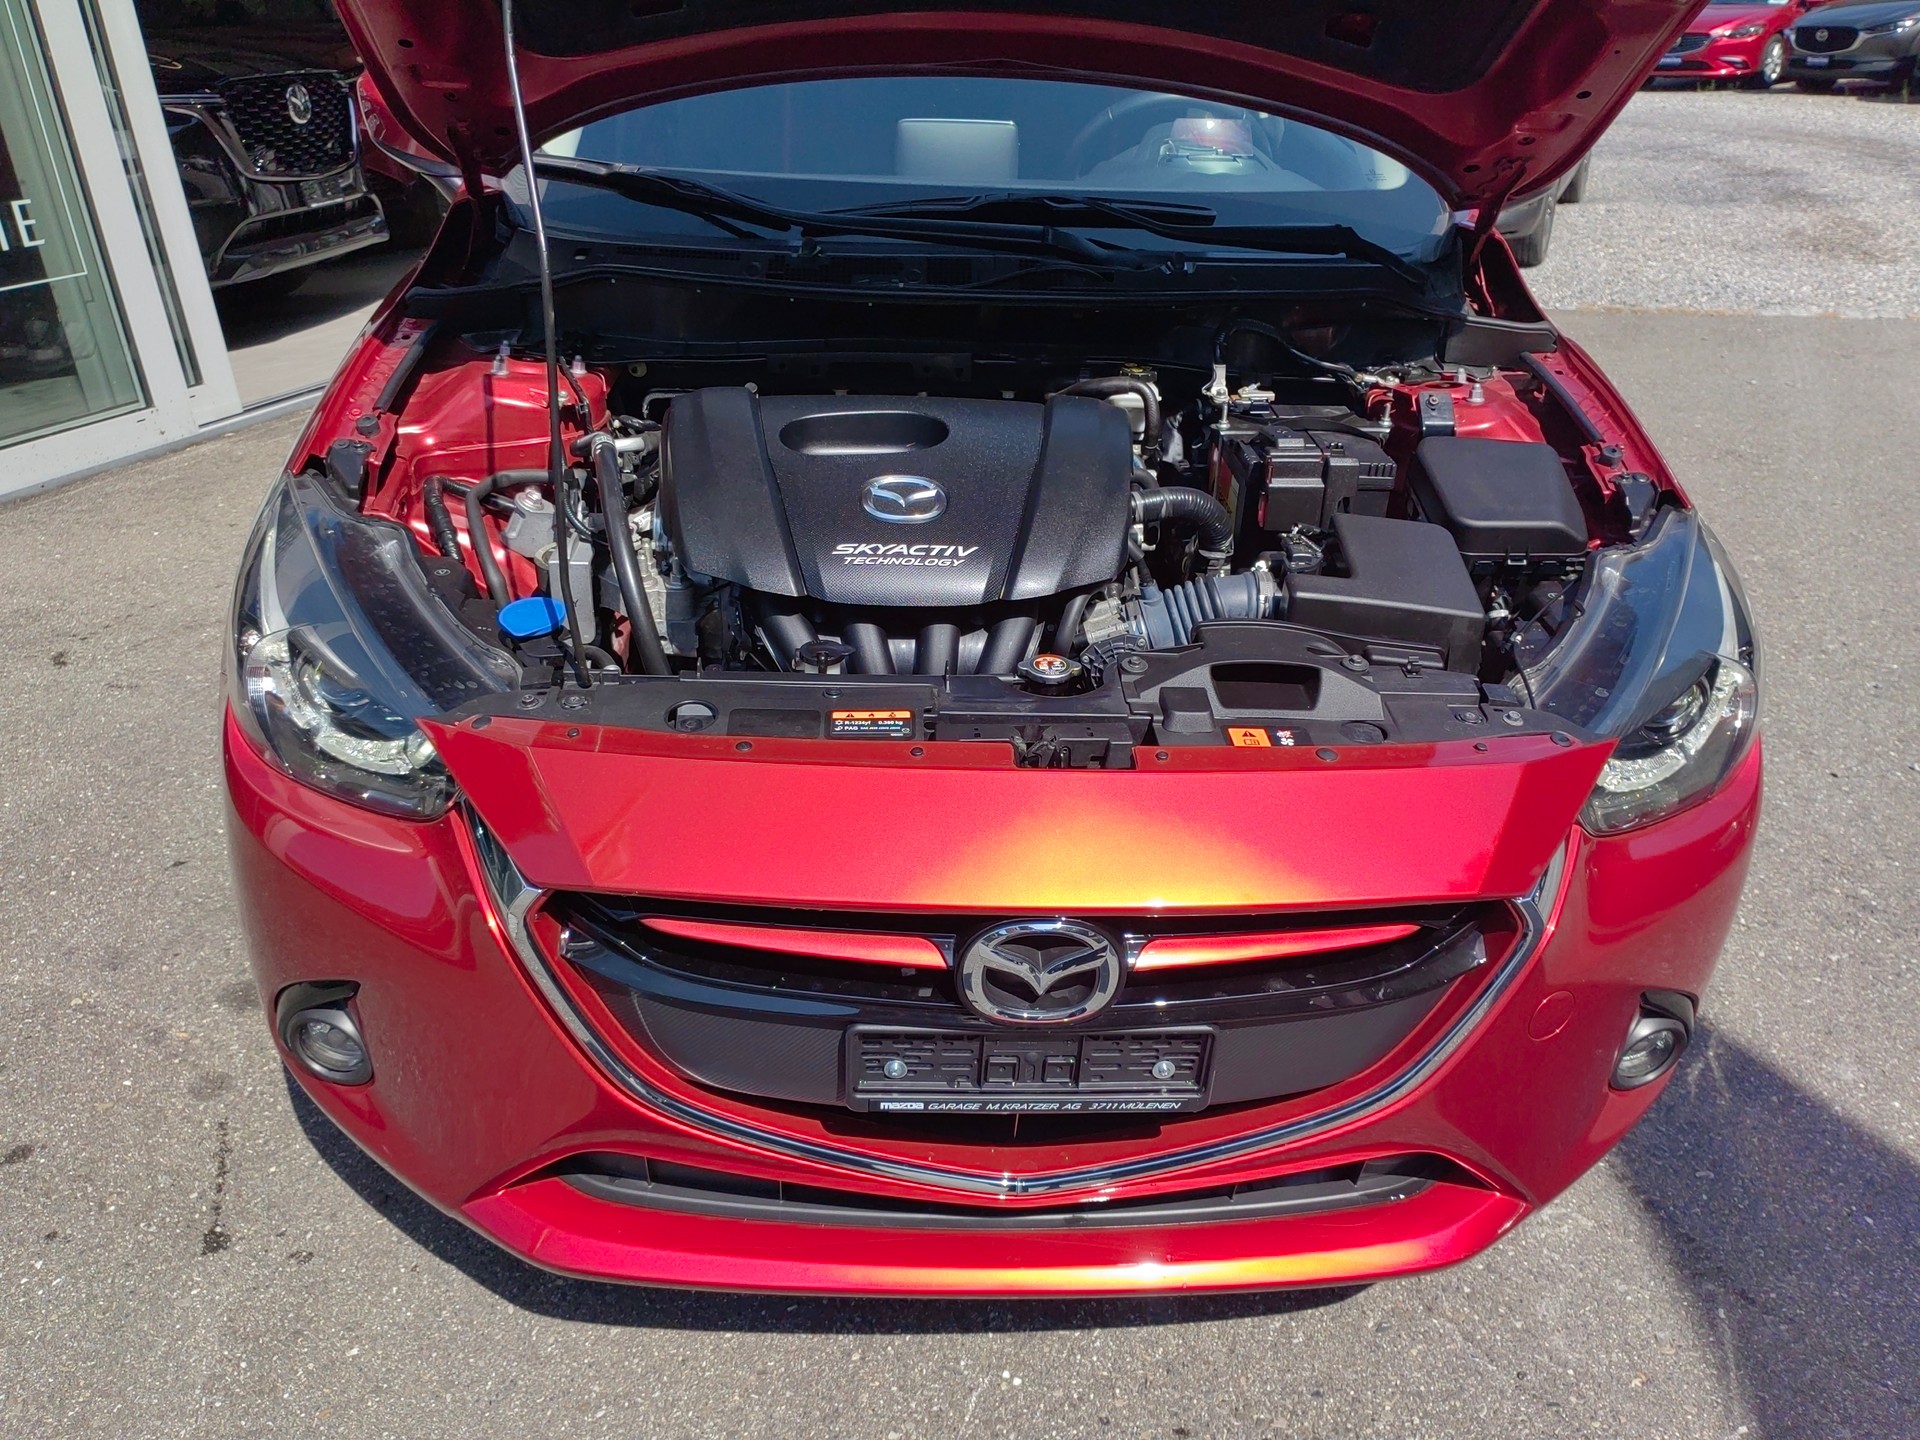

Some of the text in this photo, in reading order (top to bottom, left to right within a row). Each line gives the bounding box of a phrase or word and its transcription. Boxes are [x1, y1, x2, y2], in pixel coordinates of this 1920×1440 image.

[832, 543, 980, 557] SKYACTIV
[843, 556, 966, 567] TECHNOLOGY
[880, 1102, 925, 1110] mazda
[928, 1102, 983, 1110] GARAGE
[1062, 1102, 1083, 1110] AG
[1088, 1102, 1119, 1110] 3711
[1119, 1101, 1182, 1110] MÜLENEN
